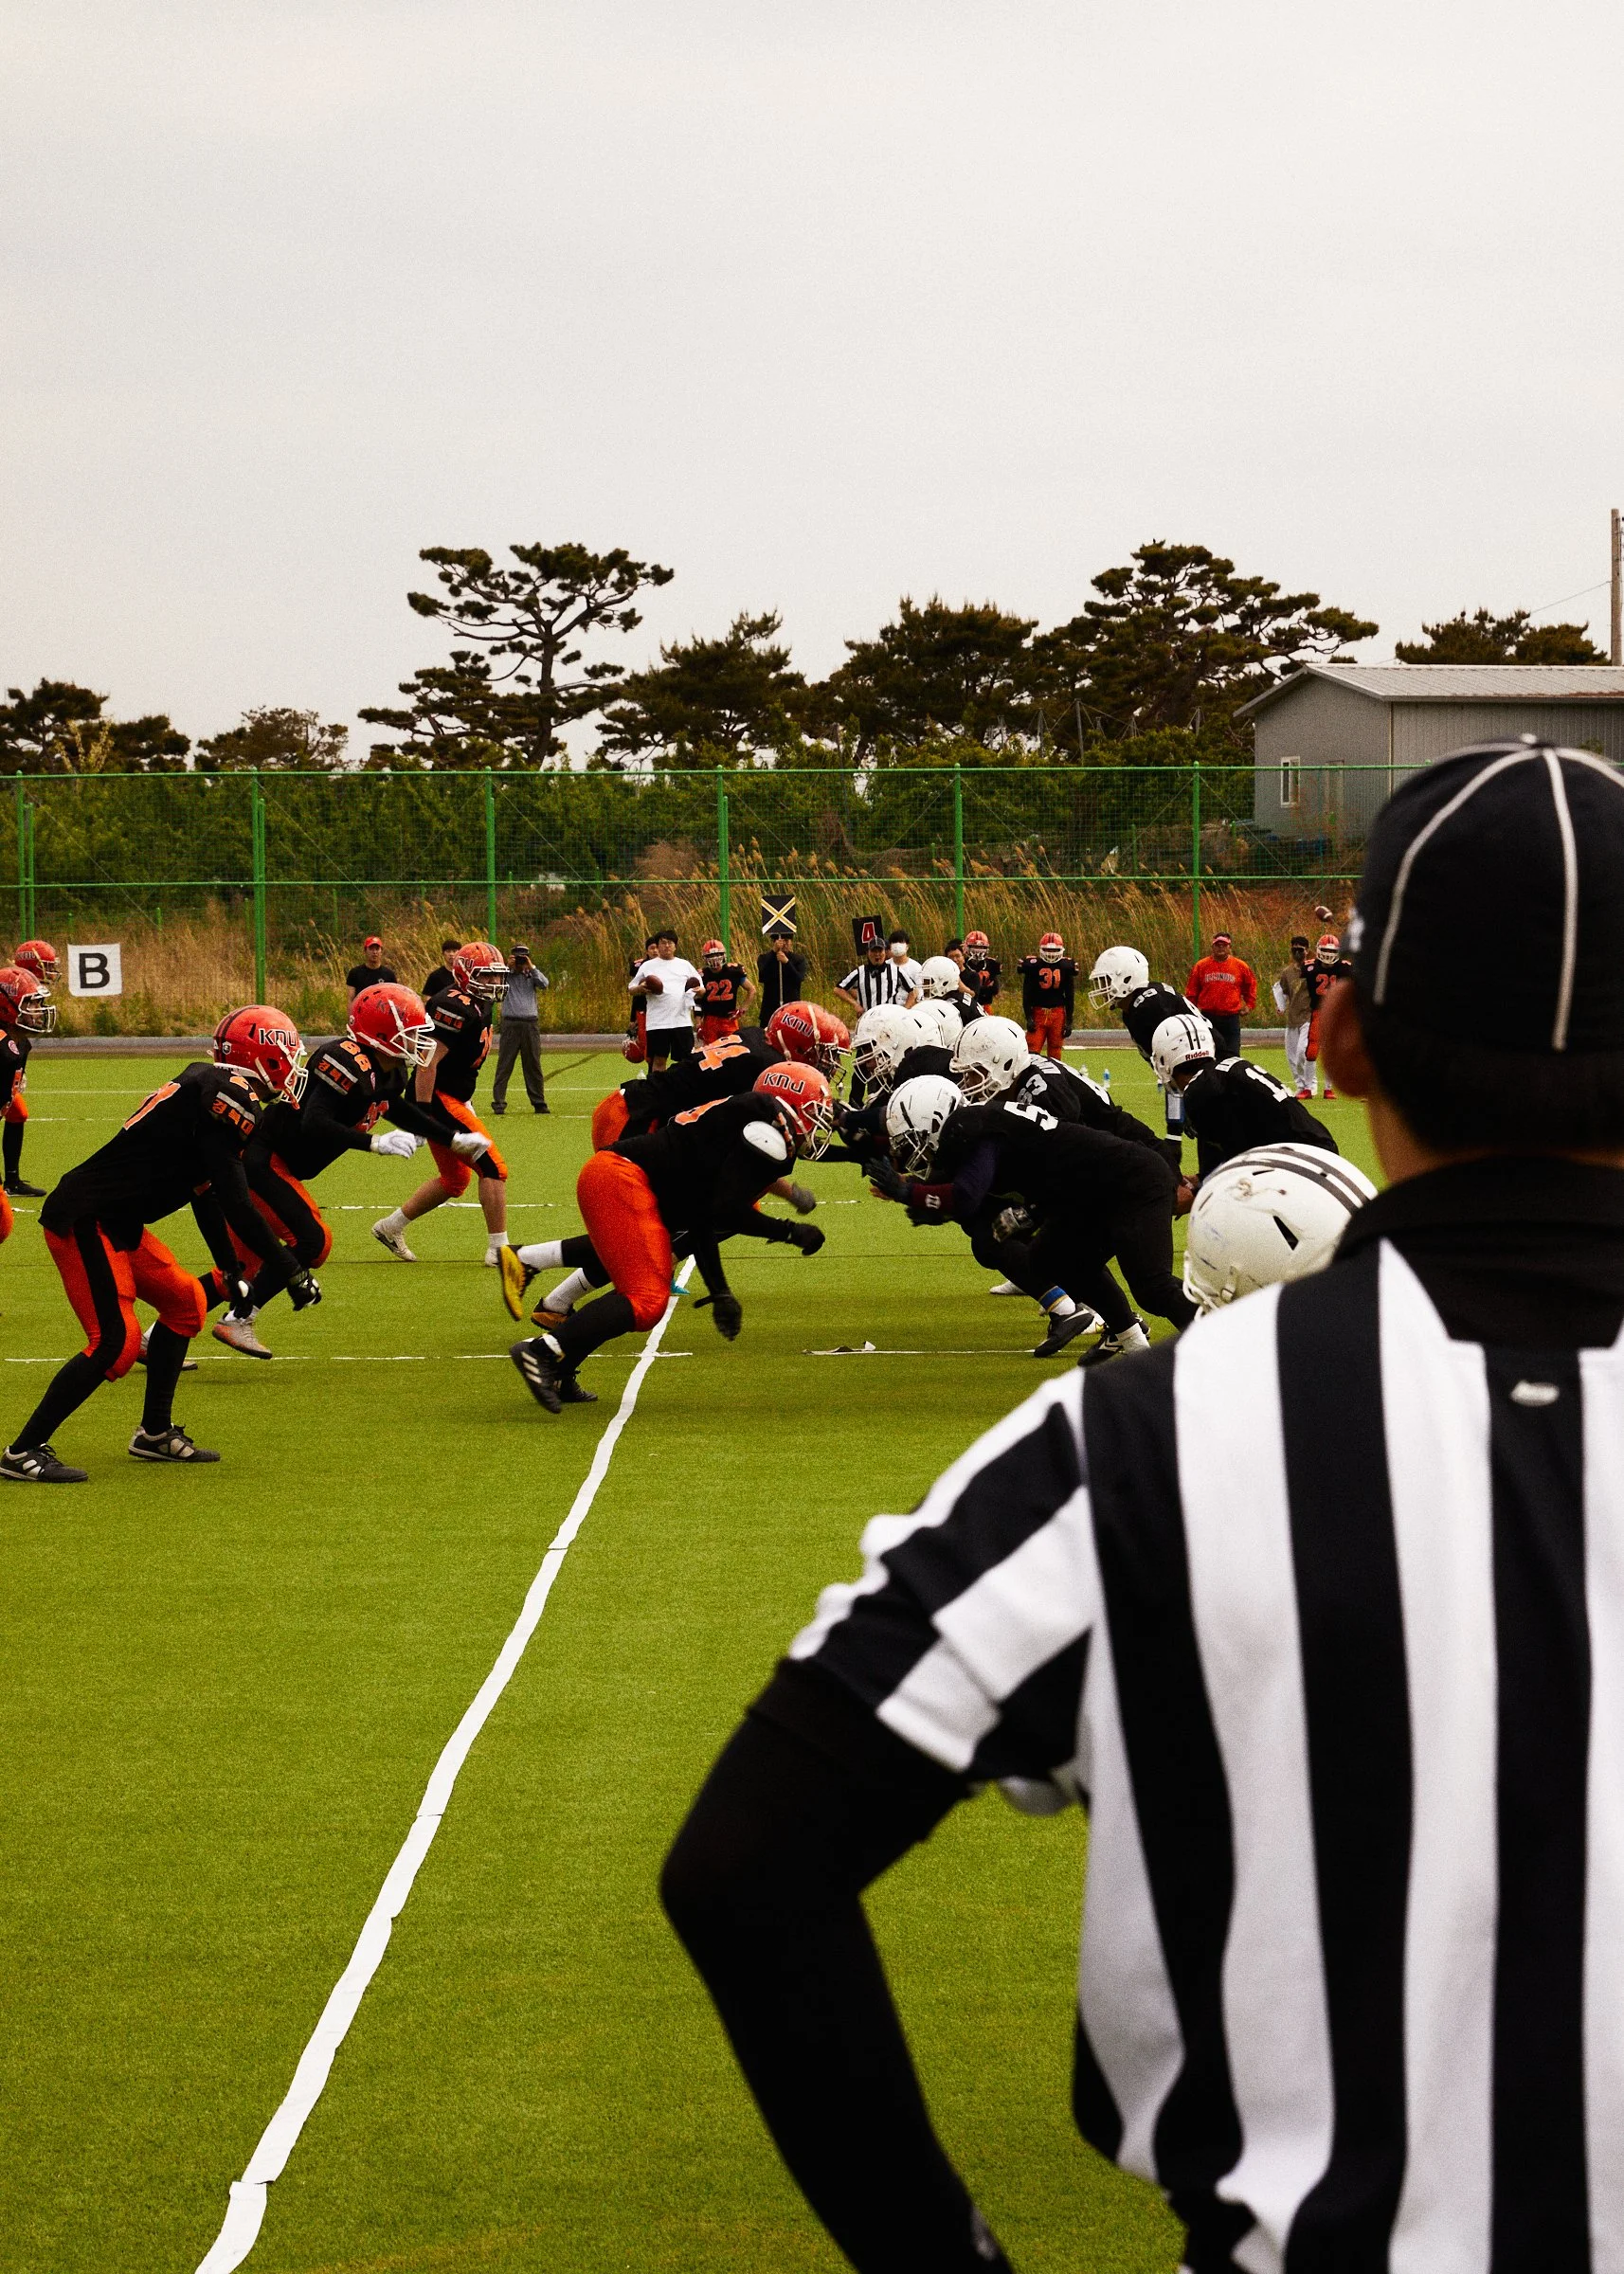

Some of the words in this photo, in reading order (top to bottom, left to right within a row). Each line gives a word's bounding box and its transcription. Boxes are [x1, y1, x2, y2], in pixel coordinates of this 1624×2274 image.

[79, 952, 110, 989] B
[1038, 967, 1061, 989] 31
[706, 979, 734, 1002] 22
[781, 1012, 815, 1038] KNU
[258, 1028, 299, 1048] KNU
[1184, 1050, 1210, 1061] Riddell
[763, 1073, 805, 1094] KNU
